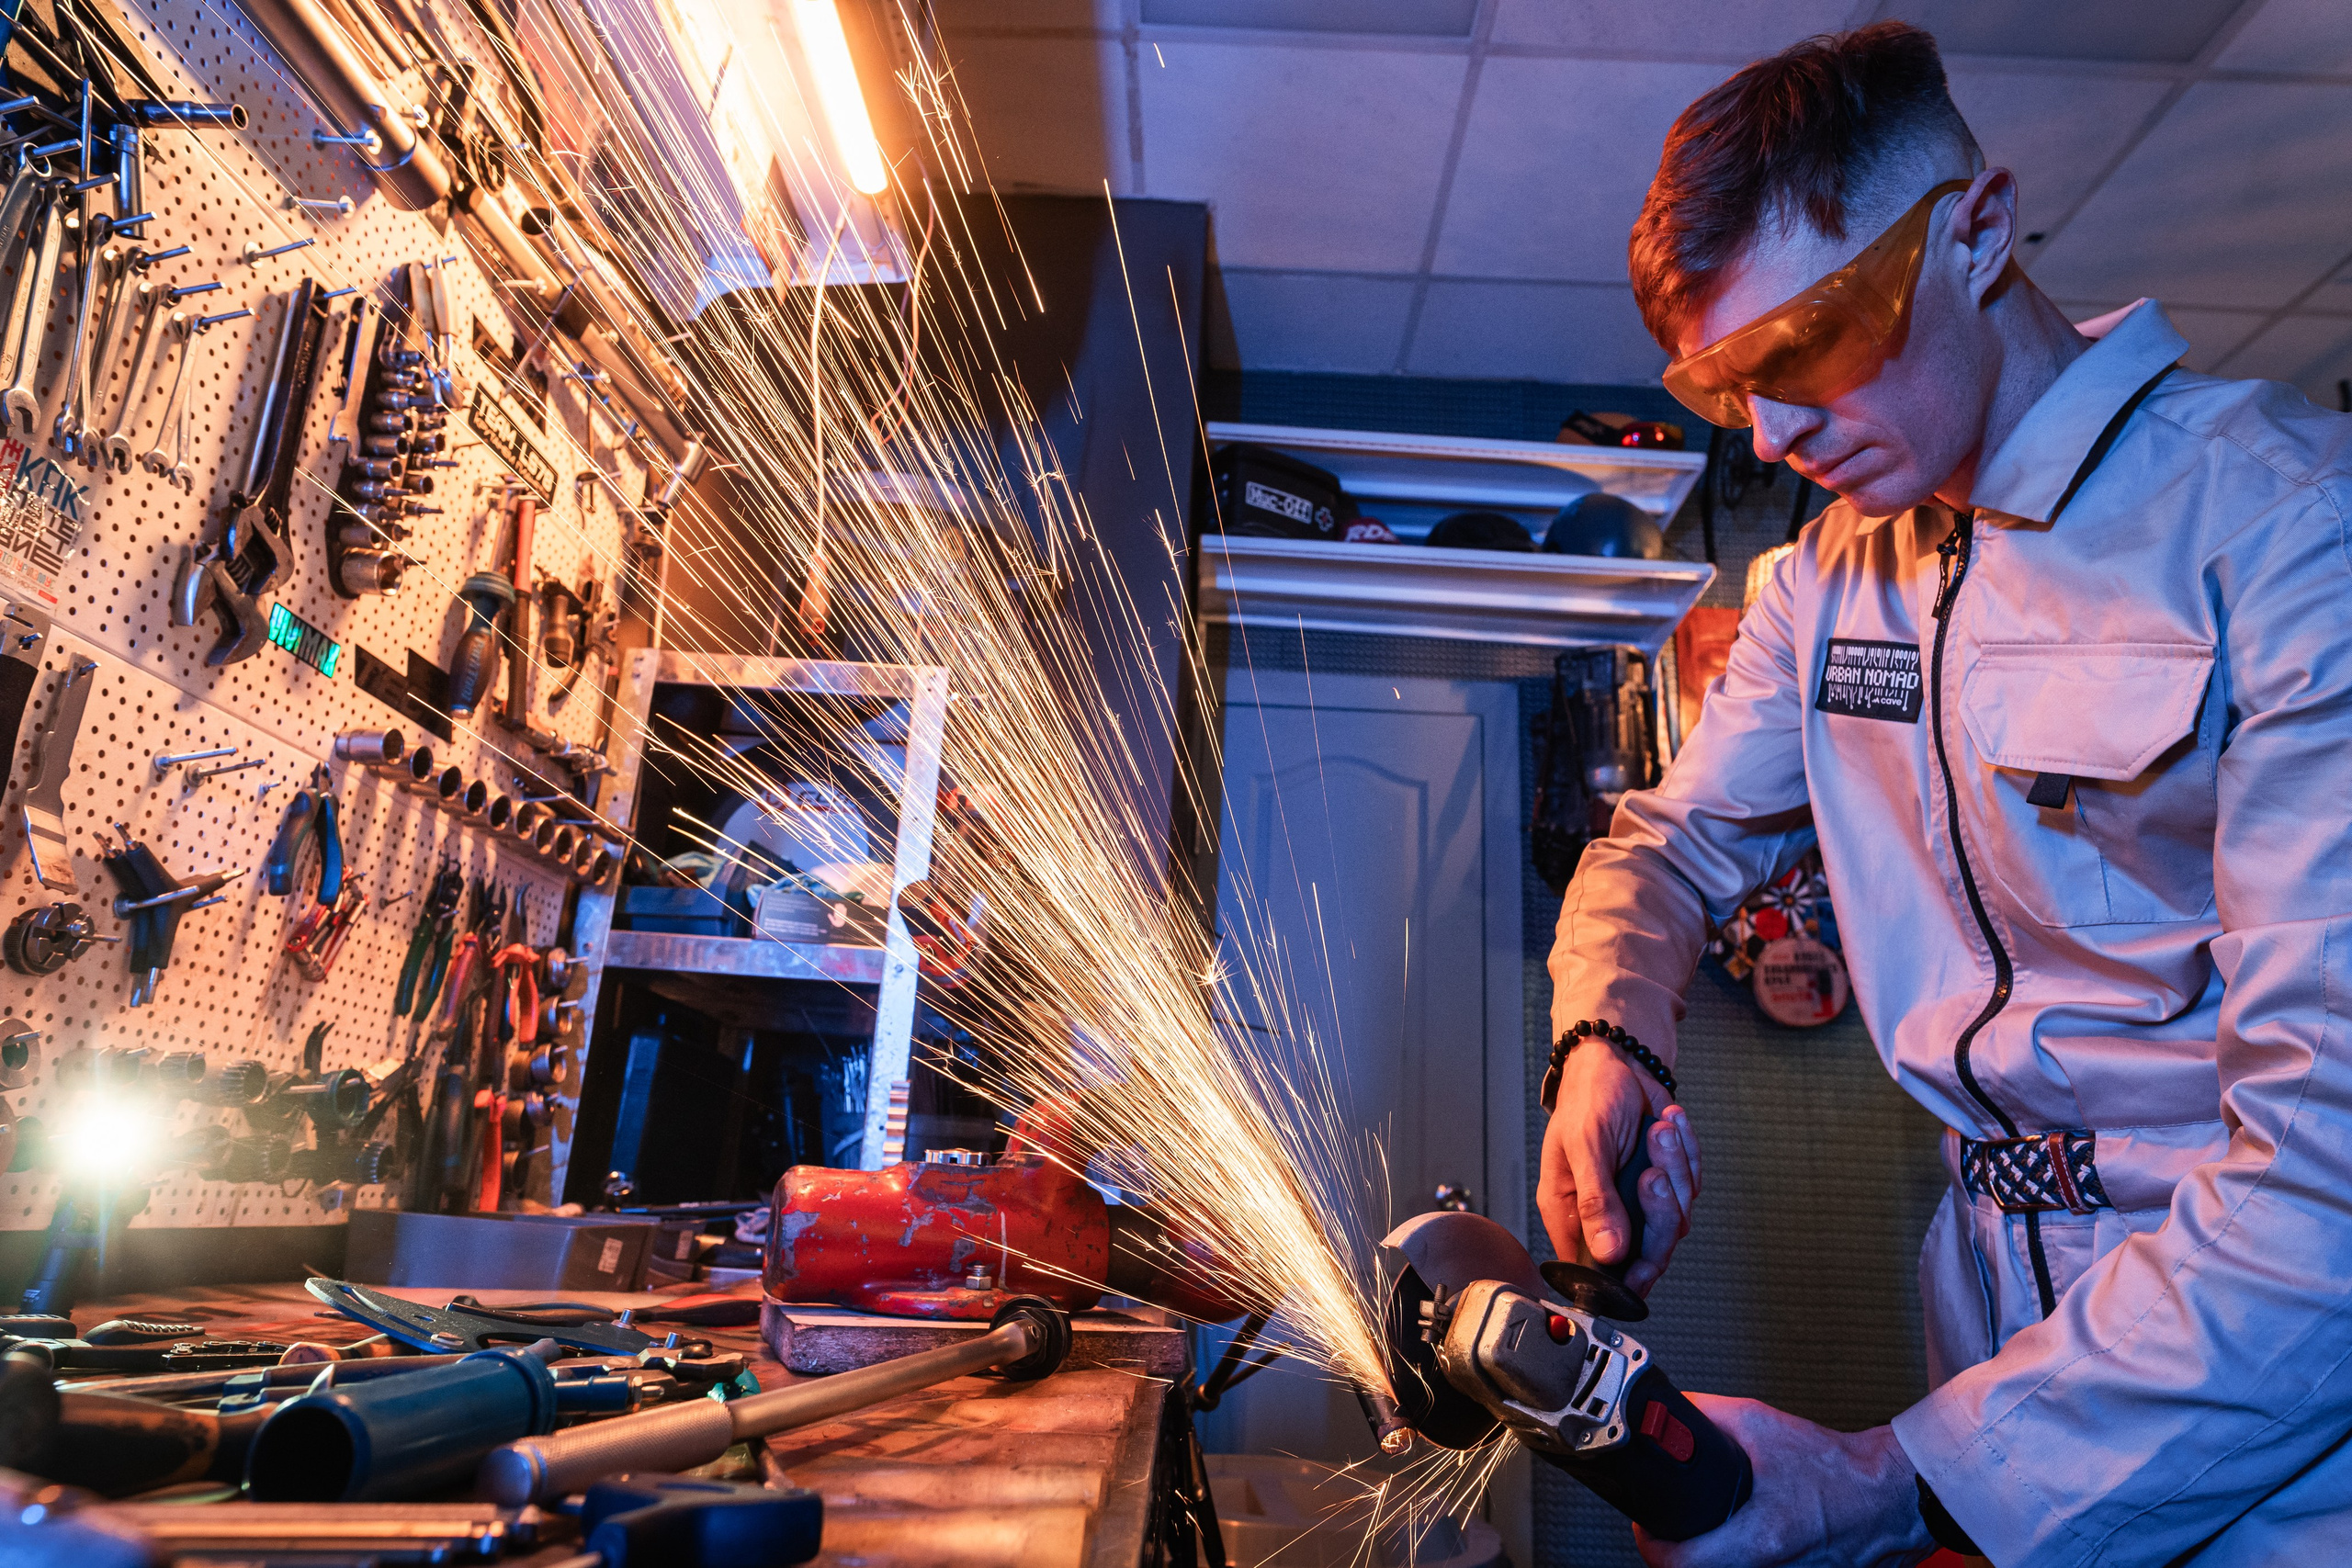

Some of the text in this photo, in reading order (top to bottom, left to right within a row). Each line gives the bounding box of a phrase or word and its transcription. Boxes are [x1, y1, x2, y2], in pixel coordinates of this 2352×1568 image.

[480, 393, 517, 450] TEAM
[15, 447, 89, 520] КАК
[1826, 665, 1920, 690] URBAN NOMAD
[1881, 697, 1903, 706] cave
